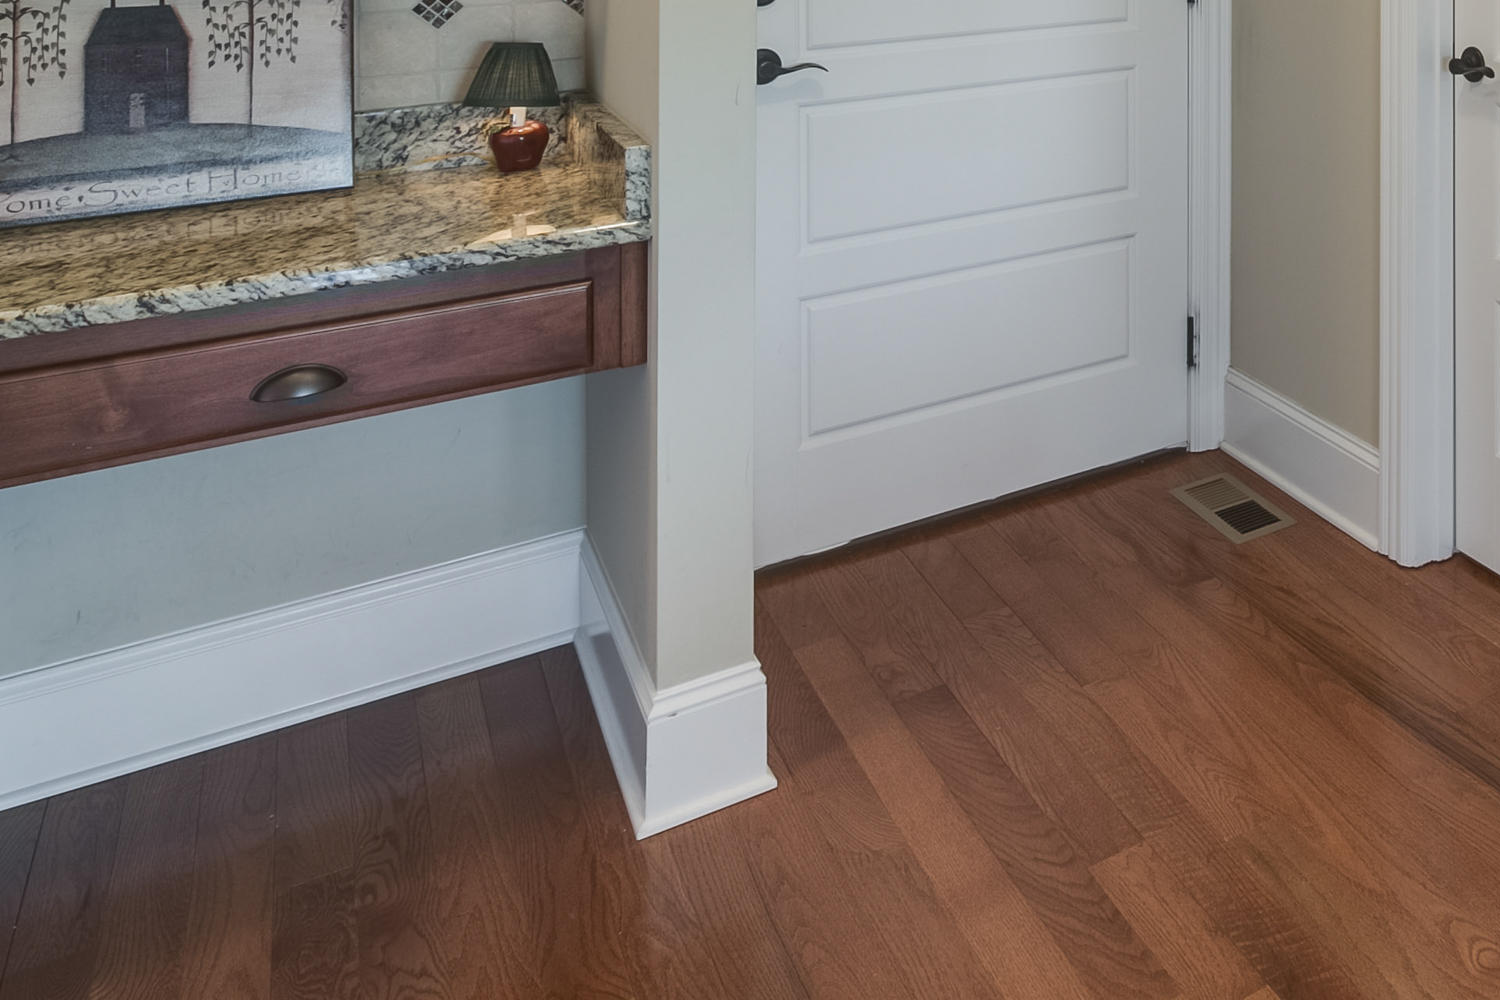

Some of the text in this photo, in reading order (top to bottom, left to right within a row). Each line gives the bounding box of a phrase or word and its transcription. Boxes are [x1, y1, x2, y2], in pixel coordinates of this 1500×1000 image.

[1, 167, 304, 214] ome Sweet Home
